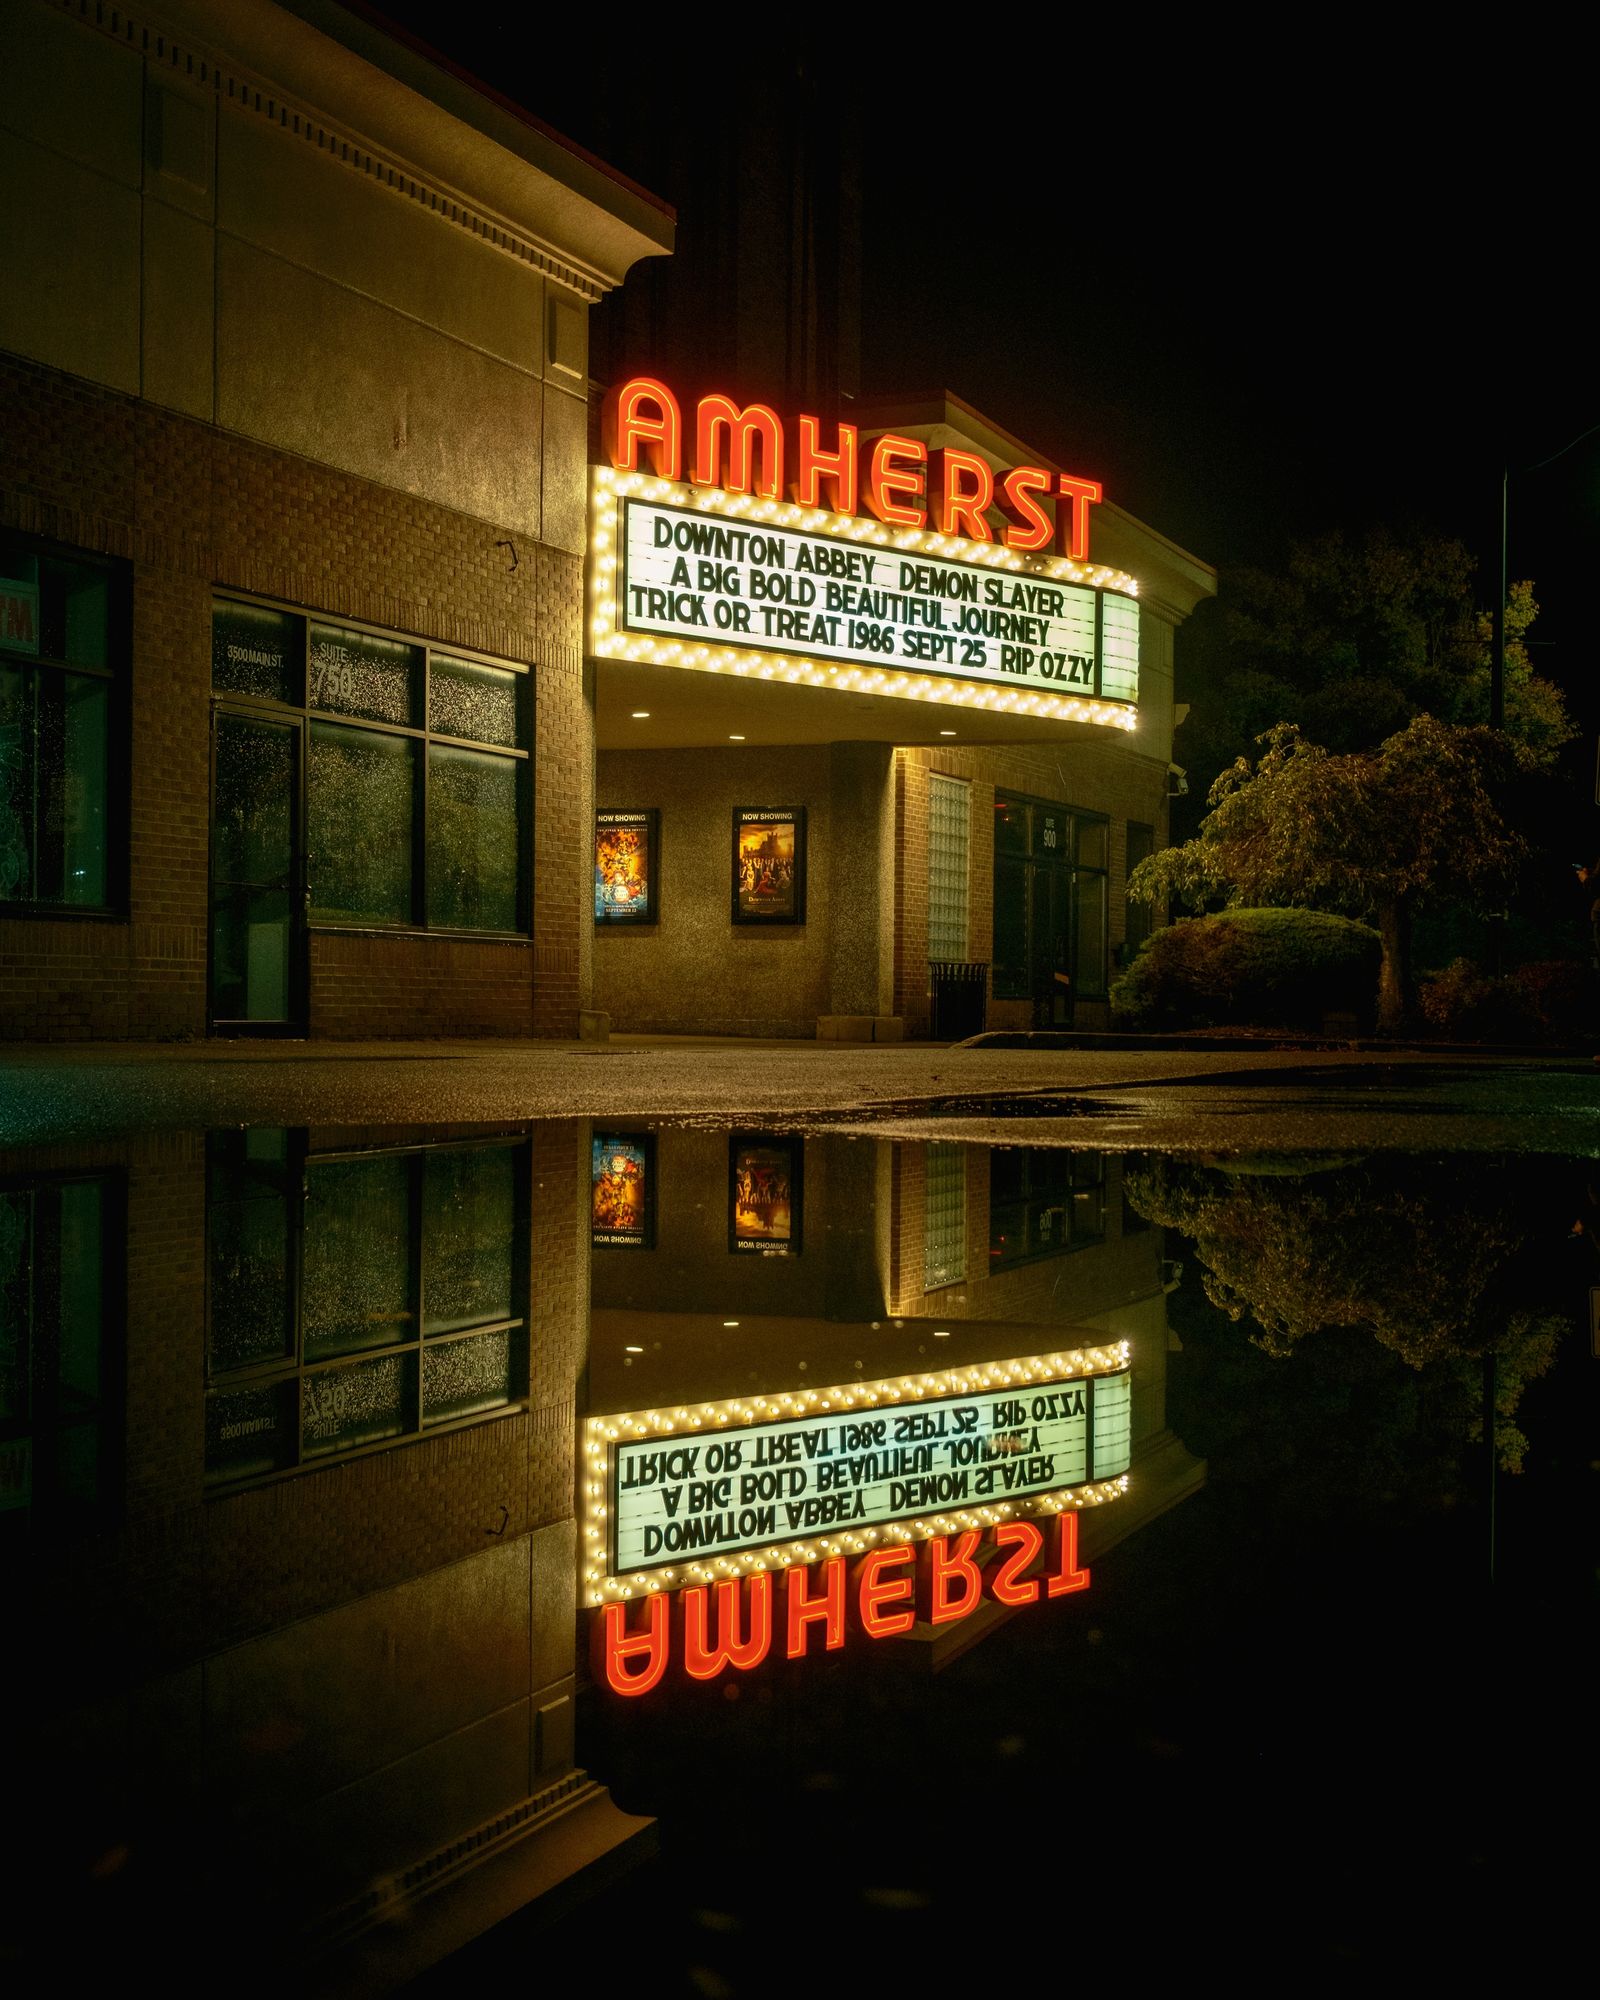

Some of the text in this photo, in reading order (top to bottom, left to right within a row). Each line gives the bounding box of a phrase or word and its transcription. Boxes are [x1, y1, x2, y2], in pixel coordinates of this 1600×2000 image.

[616, 377, 1103, 562] AMHERST
[654, 516, 1064, 618] DOWNTON ABBEY DEMON SLAYER
[670, 556, 1050, 647] A BIG BOLD BEAUTIFUL JOURNEY
[630, 585, 1094, 685] TRICK OR TREAT 1986 SEPT 25 RIP OZZY
[227, 645, 248, 661] 3500
[248, 649, 271, 666] MAIN
[319, 642, 348, 663] SUITE
[314, 661, 352, 698] 750
[614, 814, 646, 822] SHOWING
[742, 812, 793, 821] NOW SHOWING
[1043, 829, 1056, 848] 900
